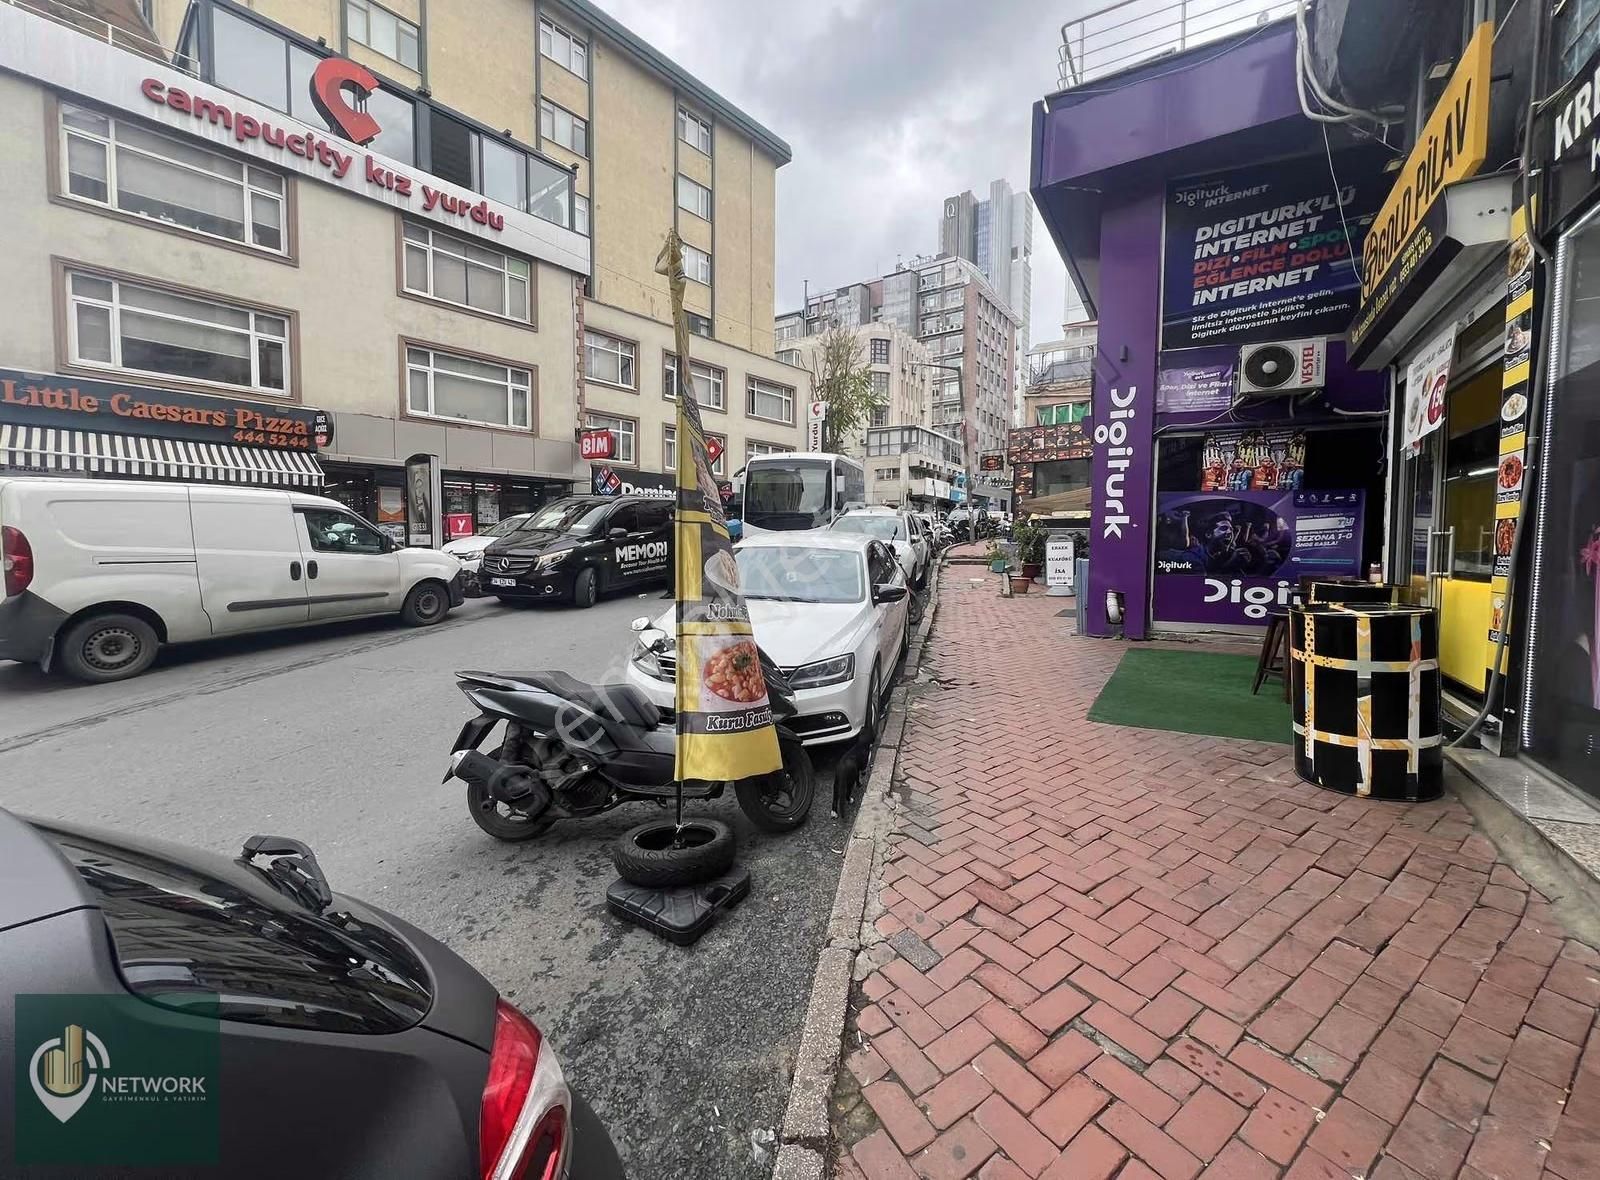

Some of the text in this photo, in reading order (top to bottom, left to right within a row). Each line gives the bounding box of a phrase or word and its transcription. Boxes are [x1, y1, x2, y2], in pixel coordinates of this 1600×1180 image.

[141, 77, 504, 232] campucity kız yurdu
[1377, 78, 1472, 276] GOLD PİLAV
[1175, 185, 1230, 207] Digiturk
[1193, 243, 1350, 289] EĞLENCE DOLU
[1191, 302, 1306, 332] limitsiz internetle birlikte
[1191, 326, 1227, 340] Digiturk
[1228, 315, 1278, 333] dünyasının
[1280, 309, 1313, 323] keyfini
[1192, 315, 1206, 323] Siz
[1207, 312, 1219, 321] de
[1220, 303, 1257, 318] Digiturk
[1301, 343, 1315, 384] VESTEL
[1, 379, 309, 436] Little Caesars Pizza
[232, 430, 265, 445] 444
[582, 433, 608, 455] BİM
[811, 423, 819, 452] Yurdu
[1094, 386, 1137, 540] Digiturk
[1295, 534, 1336, 542] SEZONA
[1158, 560, 1192, 573] Digiturk
[706, 715, 744, 731] Kuru
